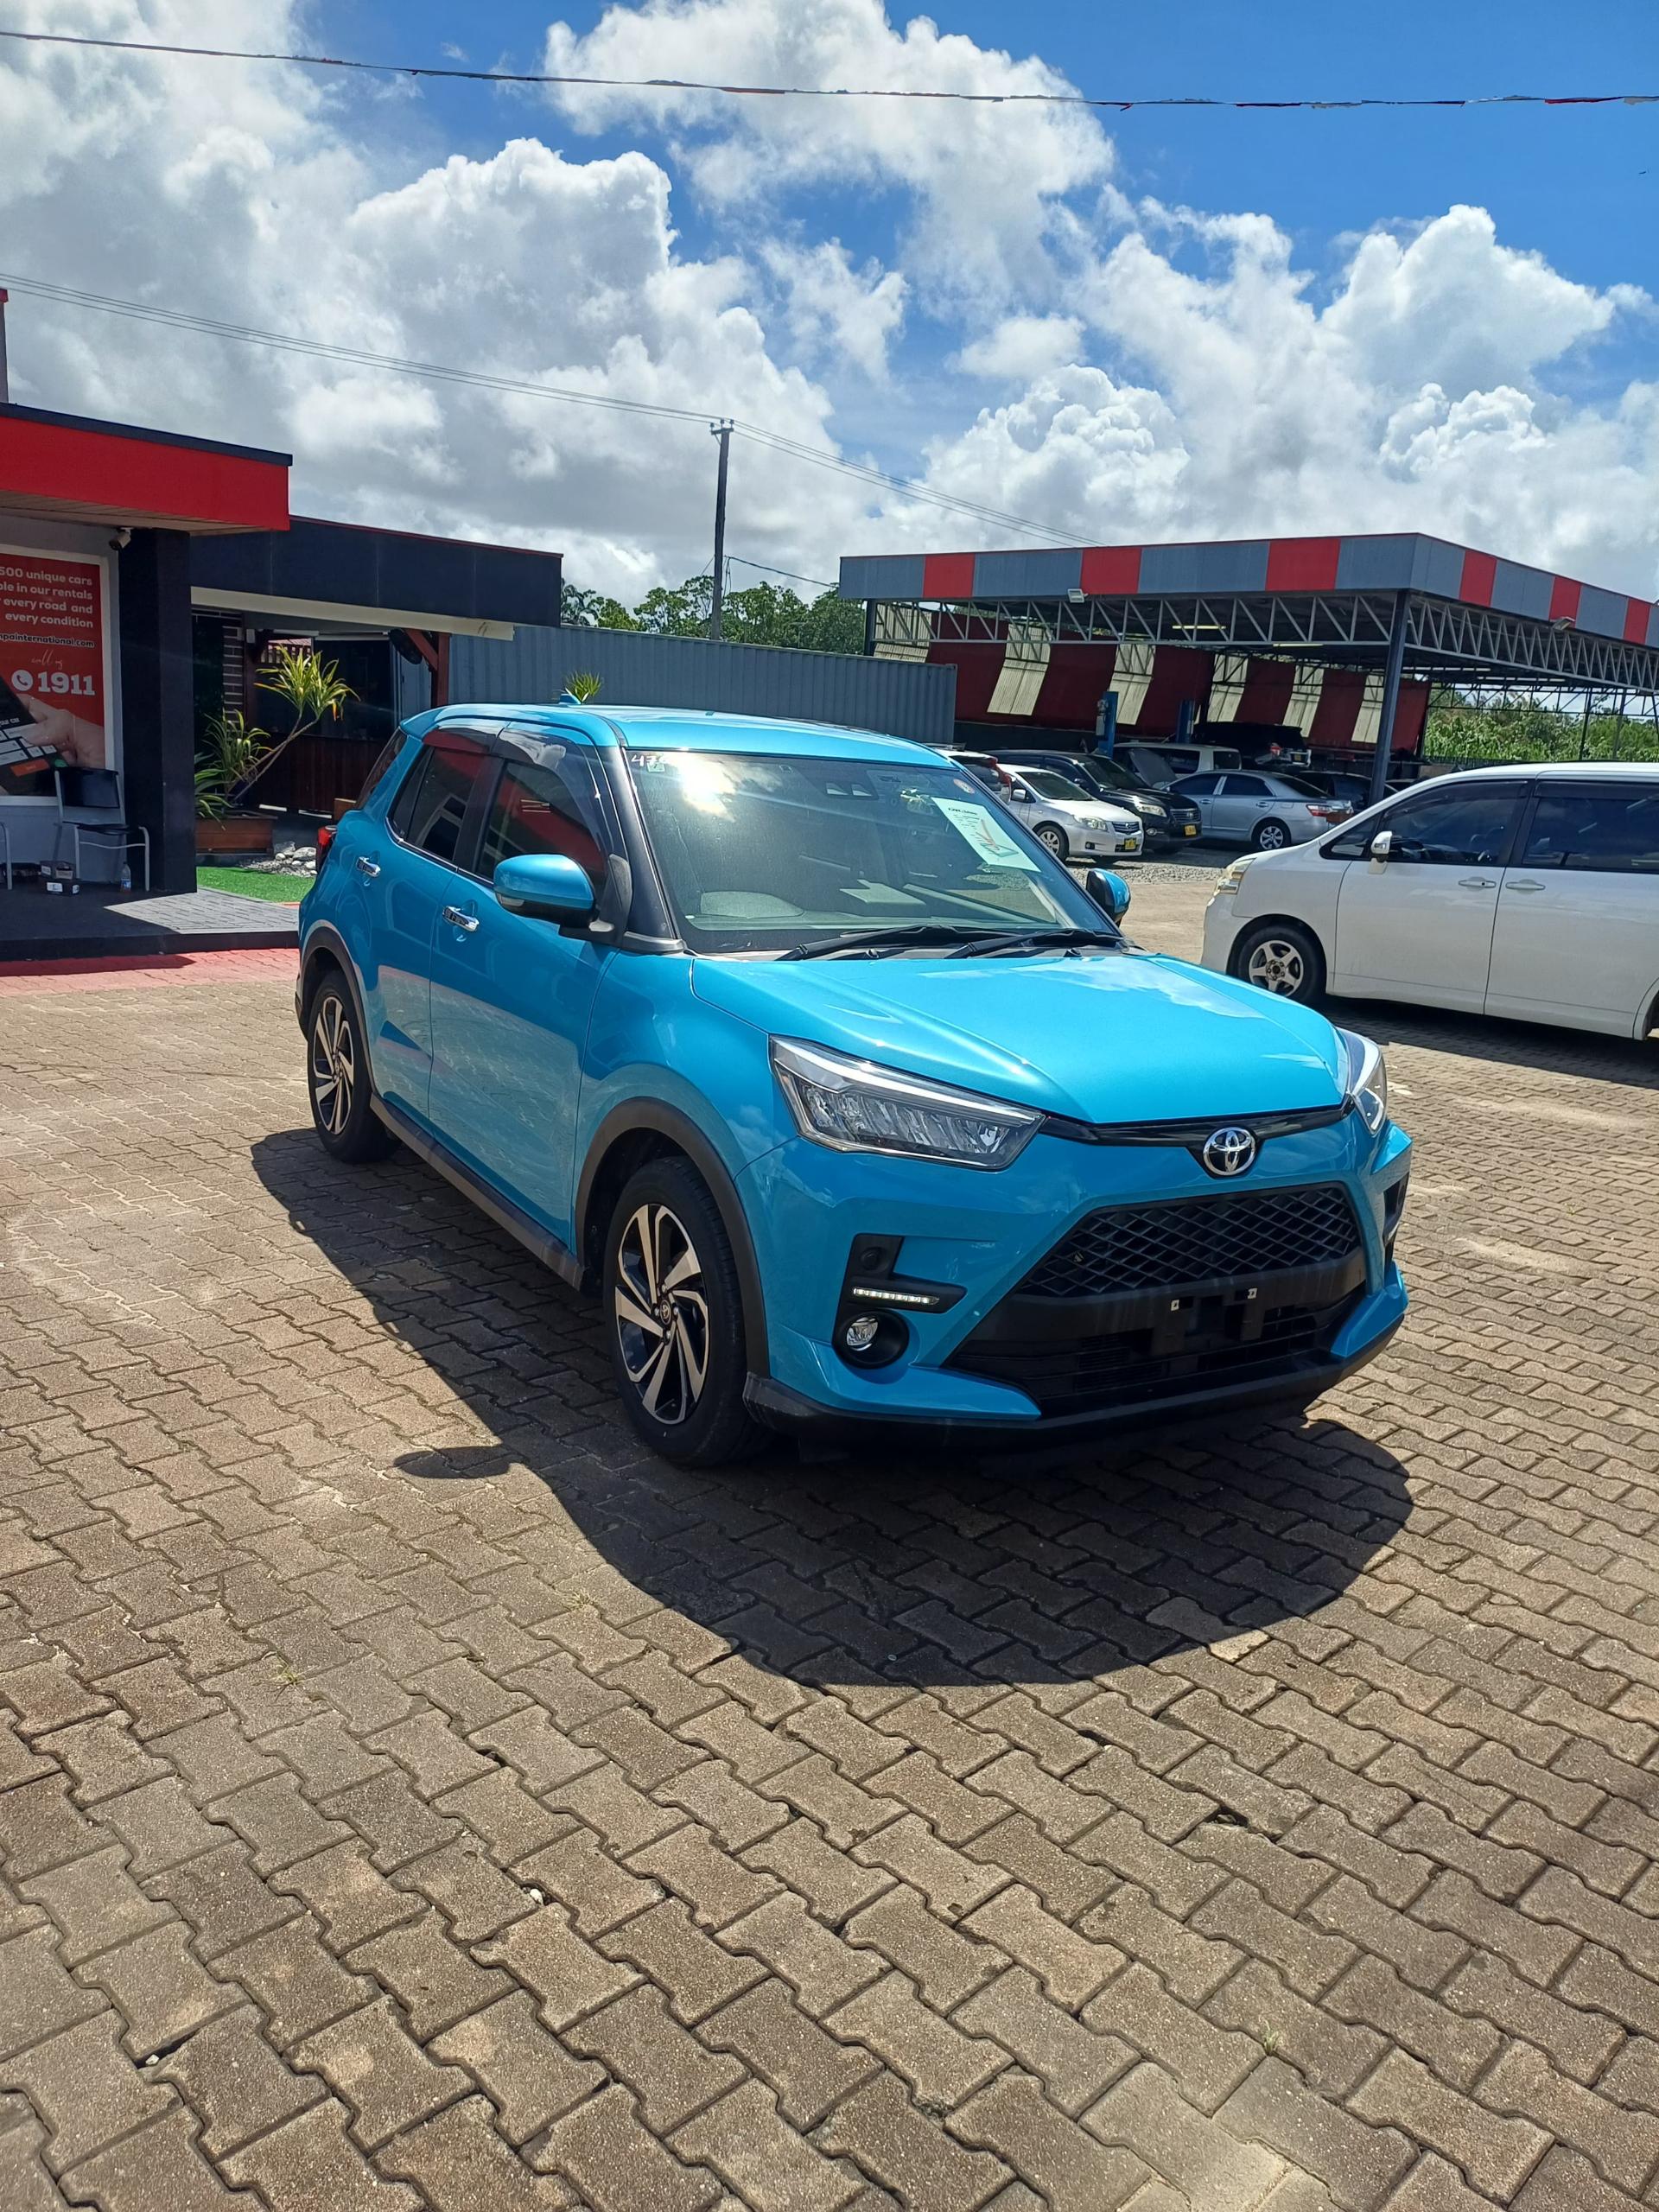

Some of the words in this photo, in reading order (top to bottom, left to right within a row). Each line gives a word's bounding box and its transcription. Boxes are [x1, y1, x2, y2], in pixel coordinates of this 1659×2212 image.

[26, 570, 66, 583] unique
[68, 576, 92, 586] cars
[16, 582, 28, 593] in
[29, 586, 51, 595] our
[52, 588, 92, 600] rentals
[3, 598, 37, 610] every
[39, 601, 67, 611] road
[71, 605, 93, 614] and
[5, 613, 39, 625] every
[41, 615, 93, 628] condition
[30, 649, 54, 665] call
[37, 671, 95, 696] 1911
